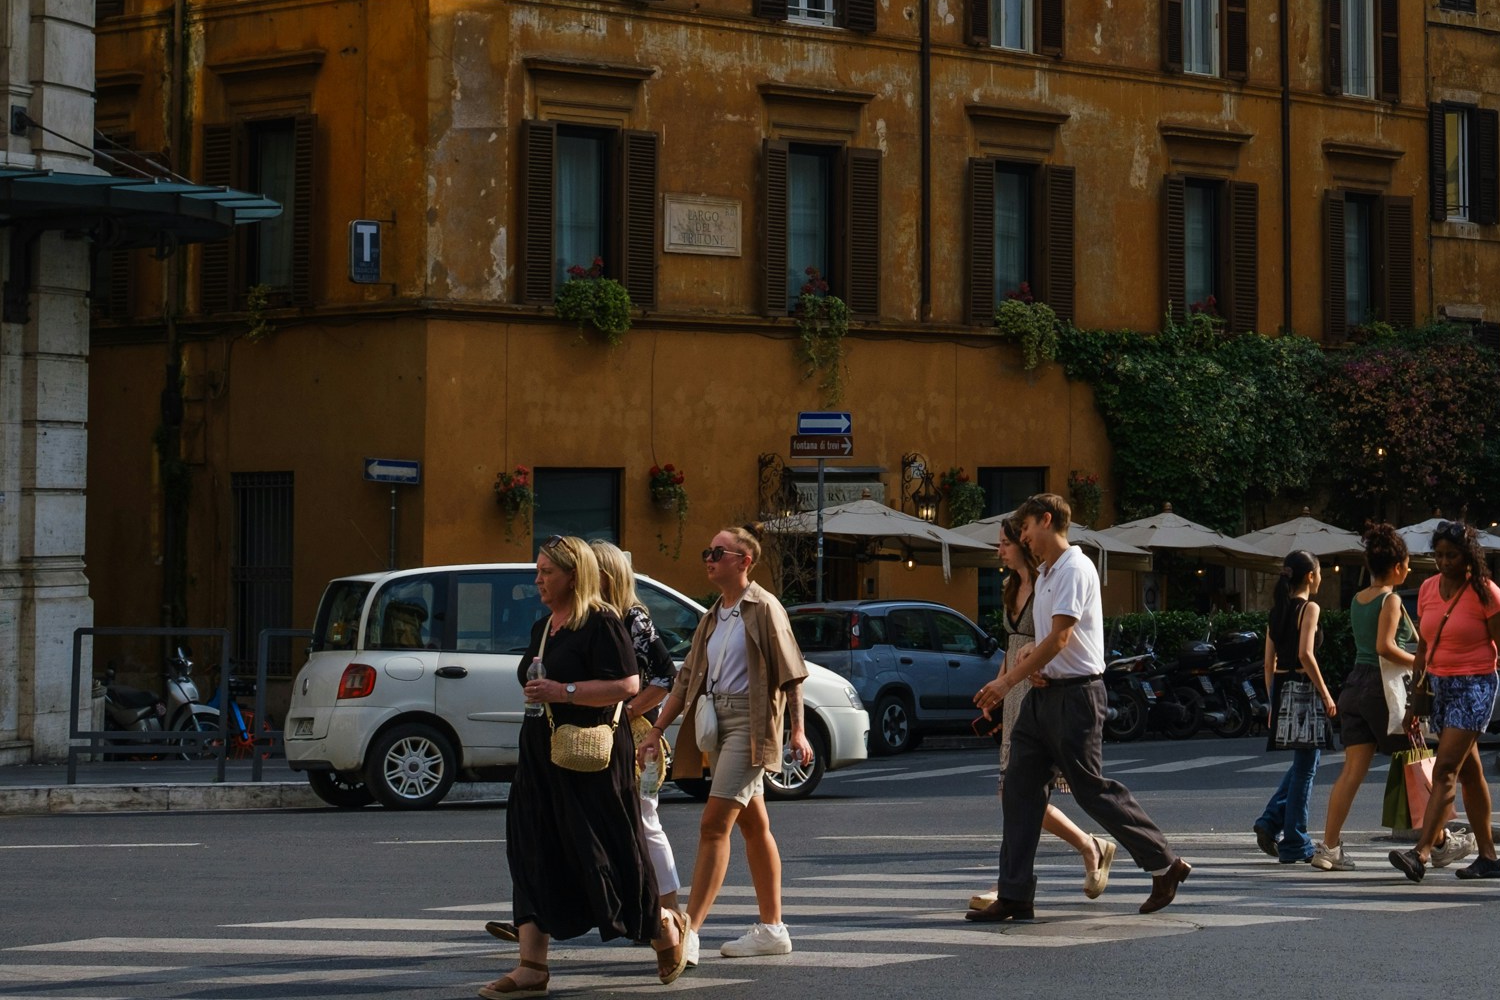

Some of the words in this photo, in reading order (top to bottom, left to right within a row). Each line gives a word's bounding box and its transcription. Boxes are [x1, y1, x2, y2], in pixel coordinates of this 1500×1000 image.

[687, 209, 719, 222] LARGO
[695, 222, 711, 233] DEL
[356, 224, 377, 262] T
[681, 232, 725, 246] TRITONE
[793, 440, 818, 450] fontana
[820, 440, 826, 450] di
[827, 440, 840, 450] trevi
